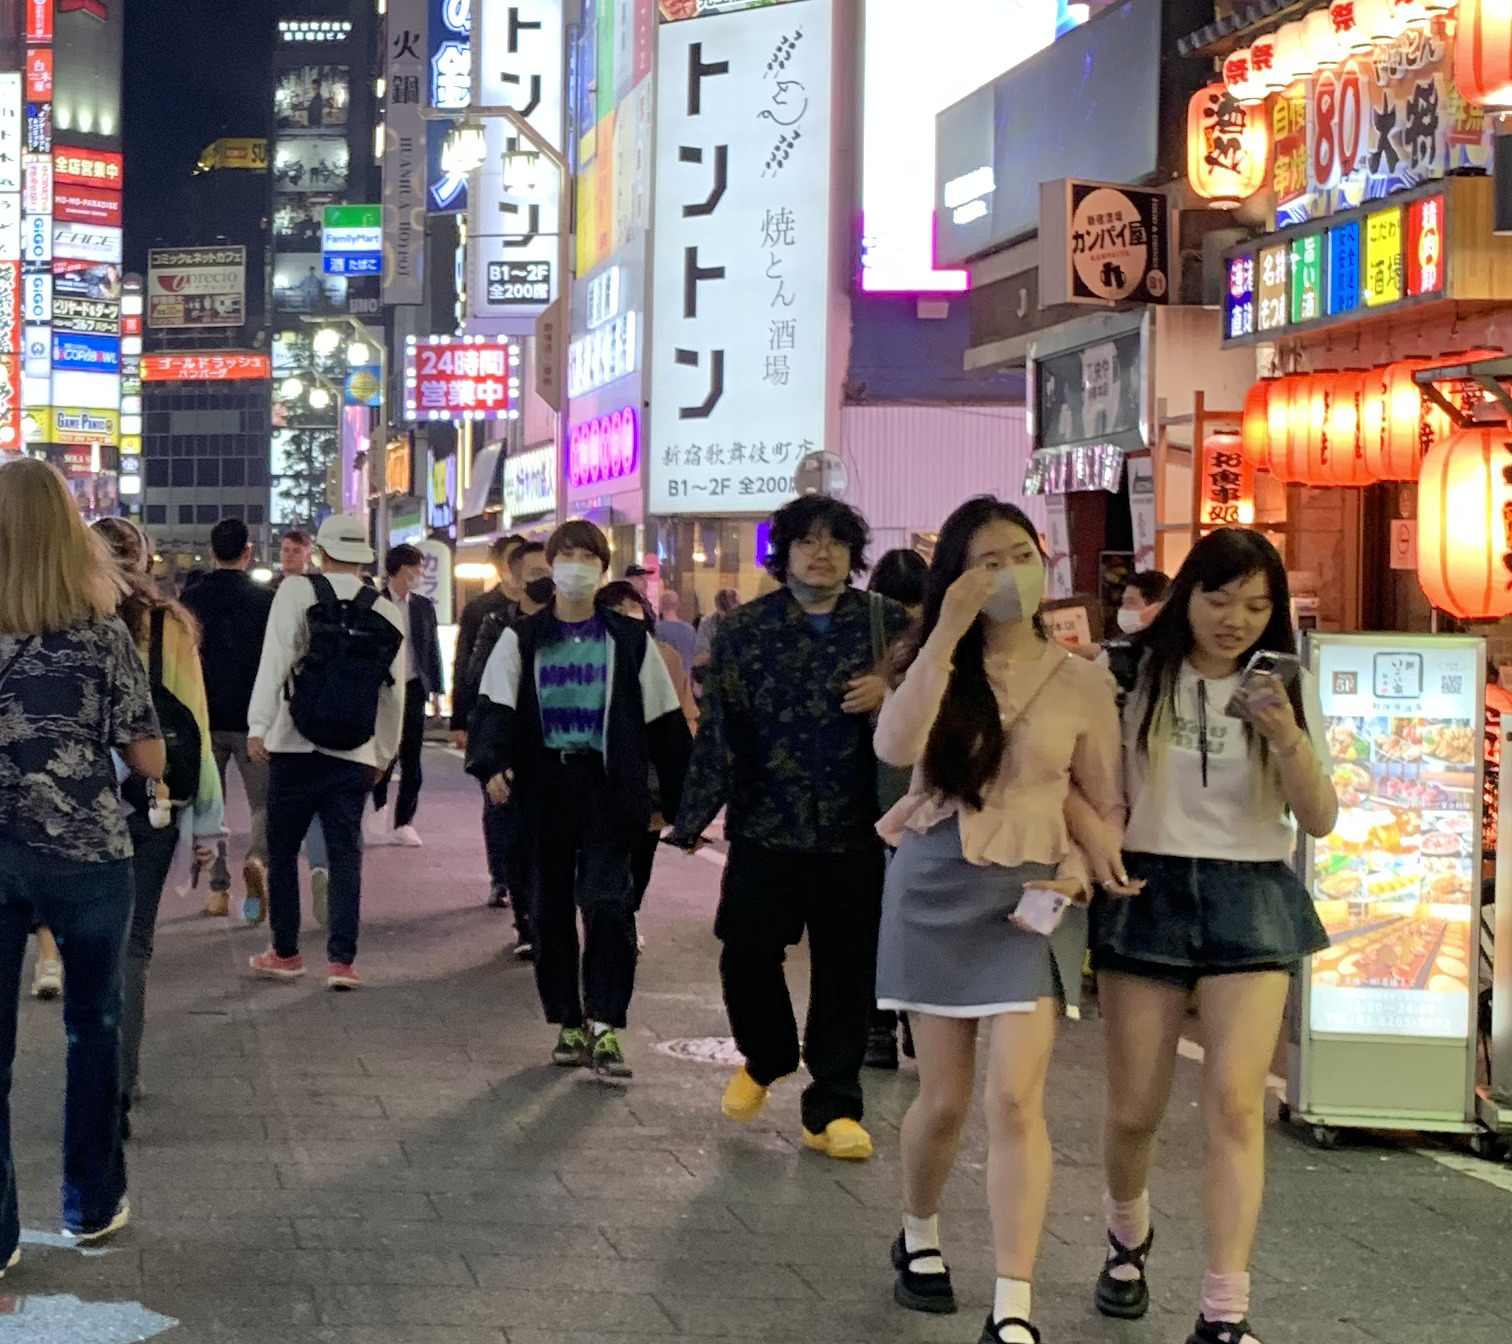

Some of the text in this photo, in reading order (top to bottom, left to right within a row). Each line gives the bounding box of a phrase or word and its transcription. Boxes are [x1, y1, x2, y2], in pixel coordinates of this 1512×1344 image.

[391, 30, 421, 105] 火鍋
[498, 6, 542, 249] トンン
[55, 155, 121, 180] 全店営業中
[54, 195, 118, 211] MO-MO-PARADISE
[32, 217, 44, 258] GiGO
[54, 230, 119, 248] FACE
[325, 232, 380, 248] FamilyMart
[674, 41, 729, 421] トントン
[1072, 221, 1147, 254] カンパイ屋
[330, 258, 378, 273] 酒 たばこ
[32, 277, 44, 318] GiGO
[489, 283, 549, 302] 全200席
[760, 207, 796, 387] 焼とん酒場
[157, 355, 263, 371] ゴールドラッシュ
[419, 349, 506, 378] 24時間
[419, 380, 505, 407] 営業中
[57, 415, 105, 433] GAME PANIC
[663, 439, 814, 467] 新宿歌舞伎町店
